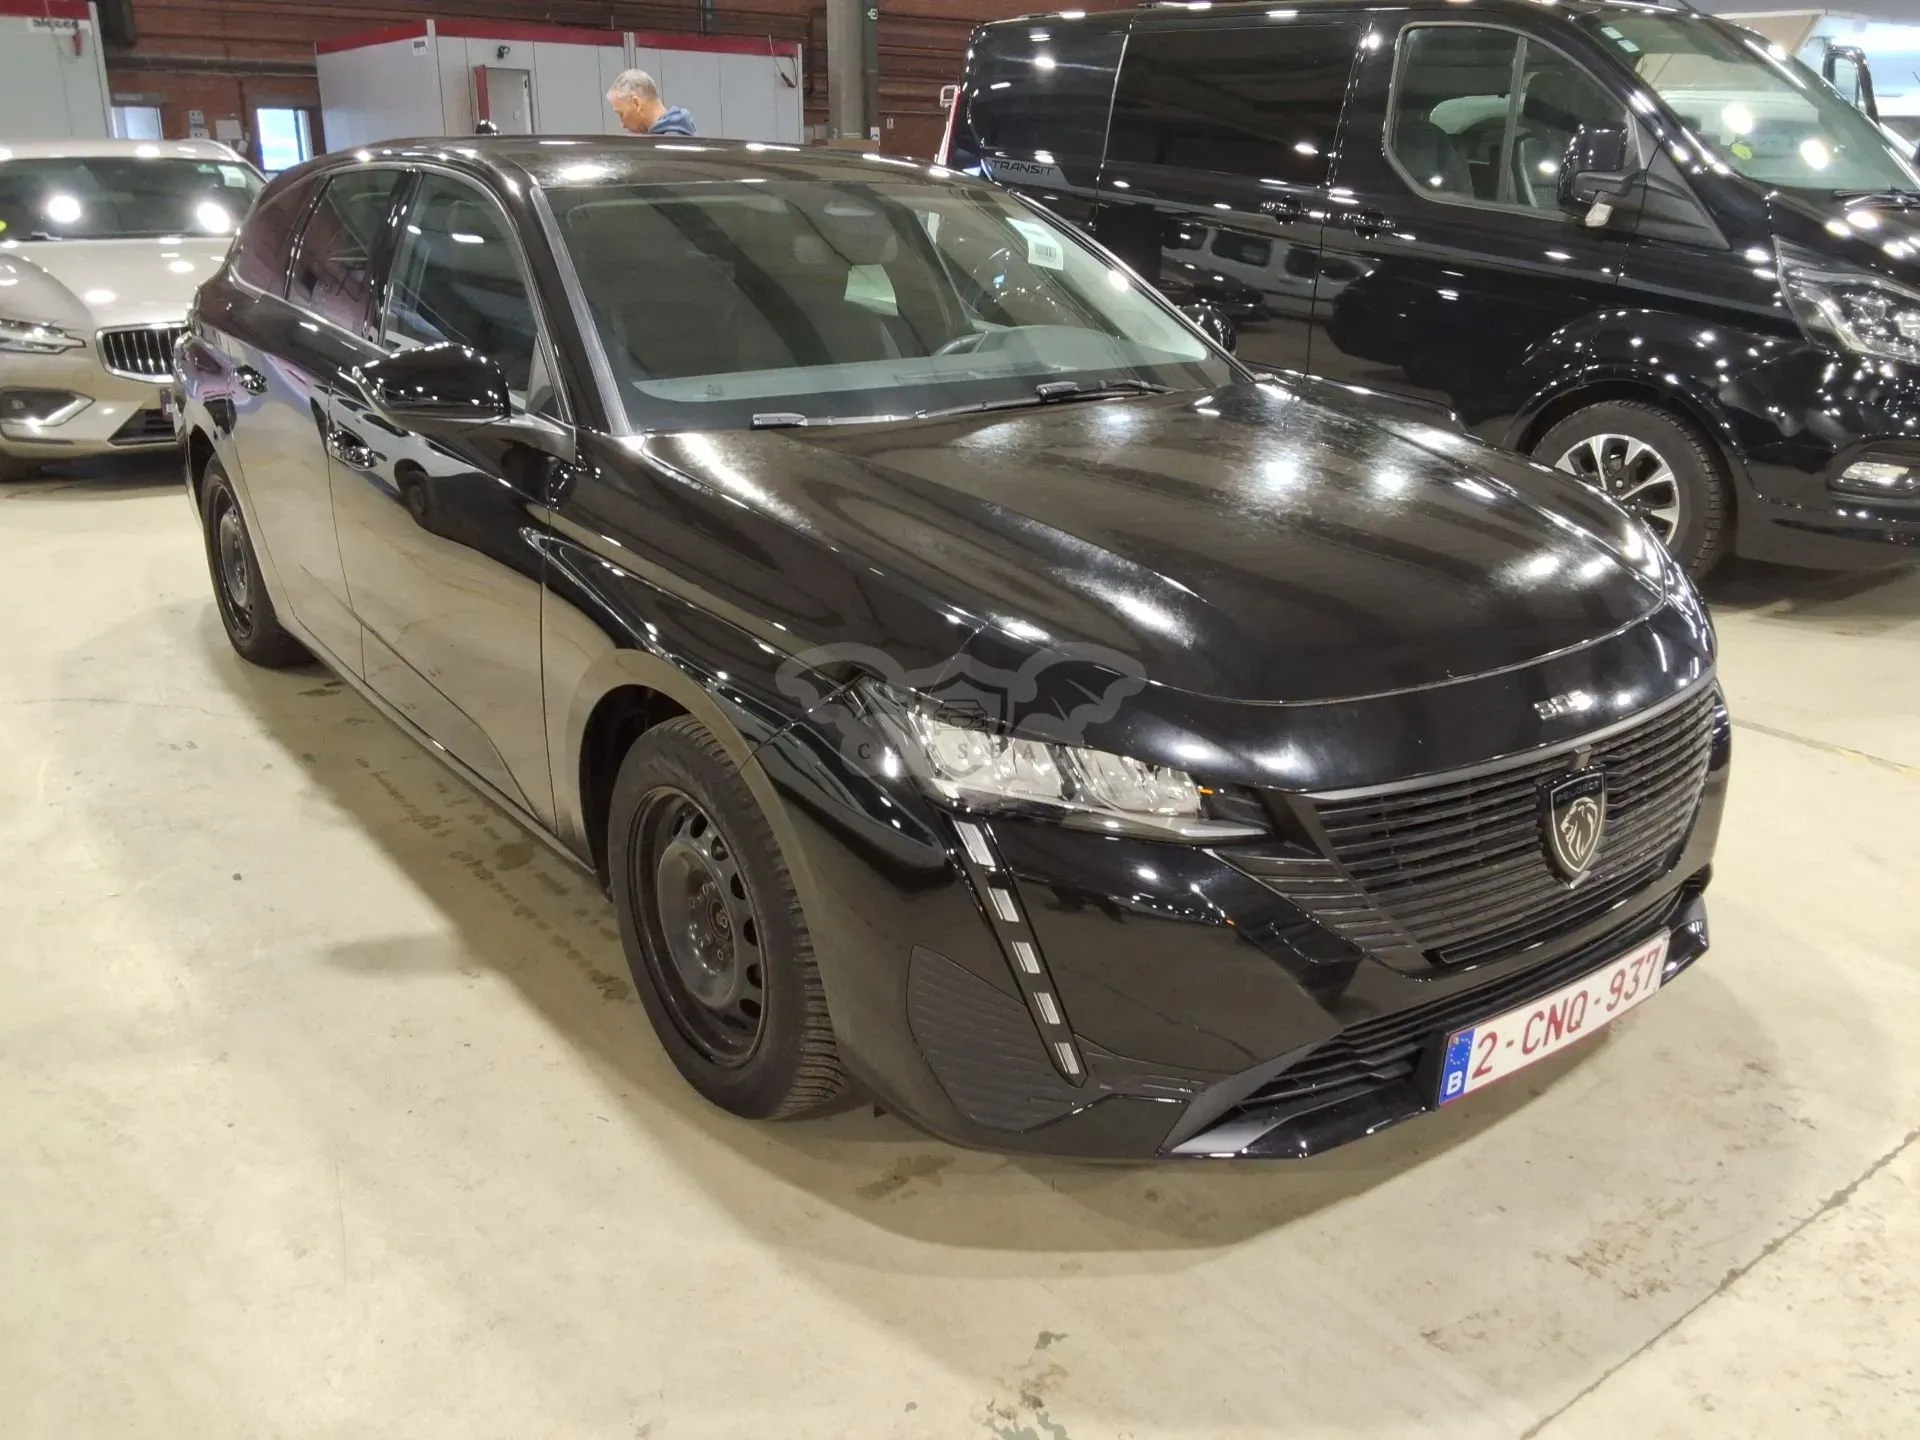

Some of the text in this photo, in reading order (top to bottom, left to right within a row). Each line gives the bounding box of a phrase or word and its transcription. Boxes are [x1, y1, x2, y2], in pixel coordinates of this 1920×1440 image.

[992, 160, 1054, 176] TRANSIT
[1471, 946, 1661, 1080] 2-CNQ-937
[1446, 1070, 1463, 1096] B
